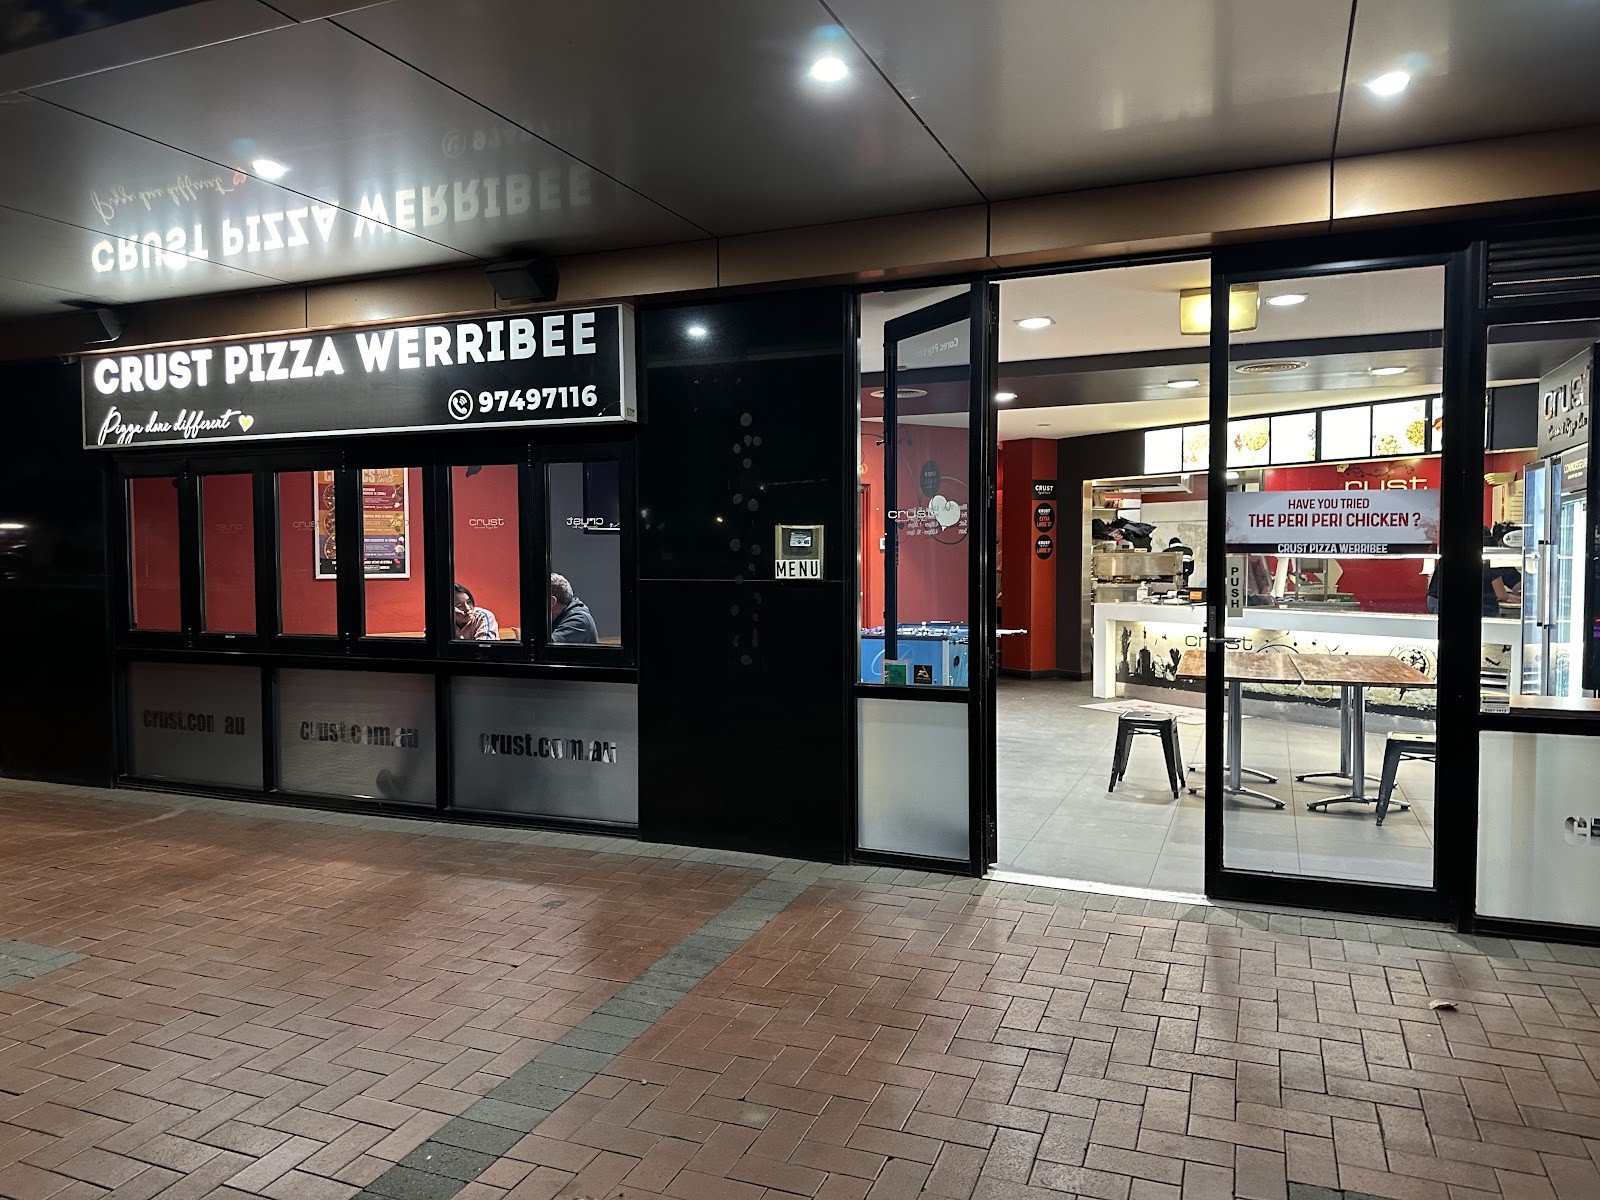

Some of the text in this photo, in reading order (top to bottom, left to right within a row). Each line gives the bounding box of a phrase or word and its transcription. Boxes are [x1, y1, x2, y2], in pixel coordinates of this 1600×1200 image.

[93, 312, 597, 395] CRUST PIZZA WERRIBEE
[478, 385, 598, 413] 97497116
[97, 406, 242, 446] Pizza done different
[1288, 498, 1370, 509] HAVE YOU TRIED
[469, 517, 505, 526] crust
[1248, 512, 1421, 528] THE PERI PERI CHICKEN ?
[1277, 543, 1388, 554] CRUST PIZZA WERRIBEE
[776, 560, 819, 578] MENU
[1231, 566, 1240, 608] PUSH
[1185, 635, 1253, 651] crst
[479, 733, 617, 764] crust.com.au
